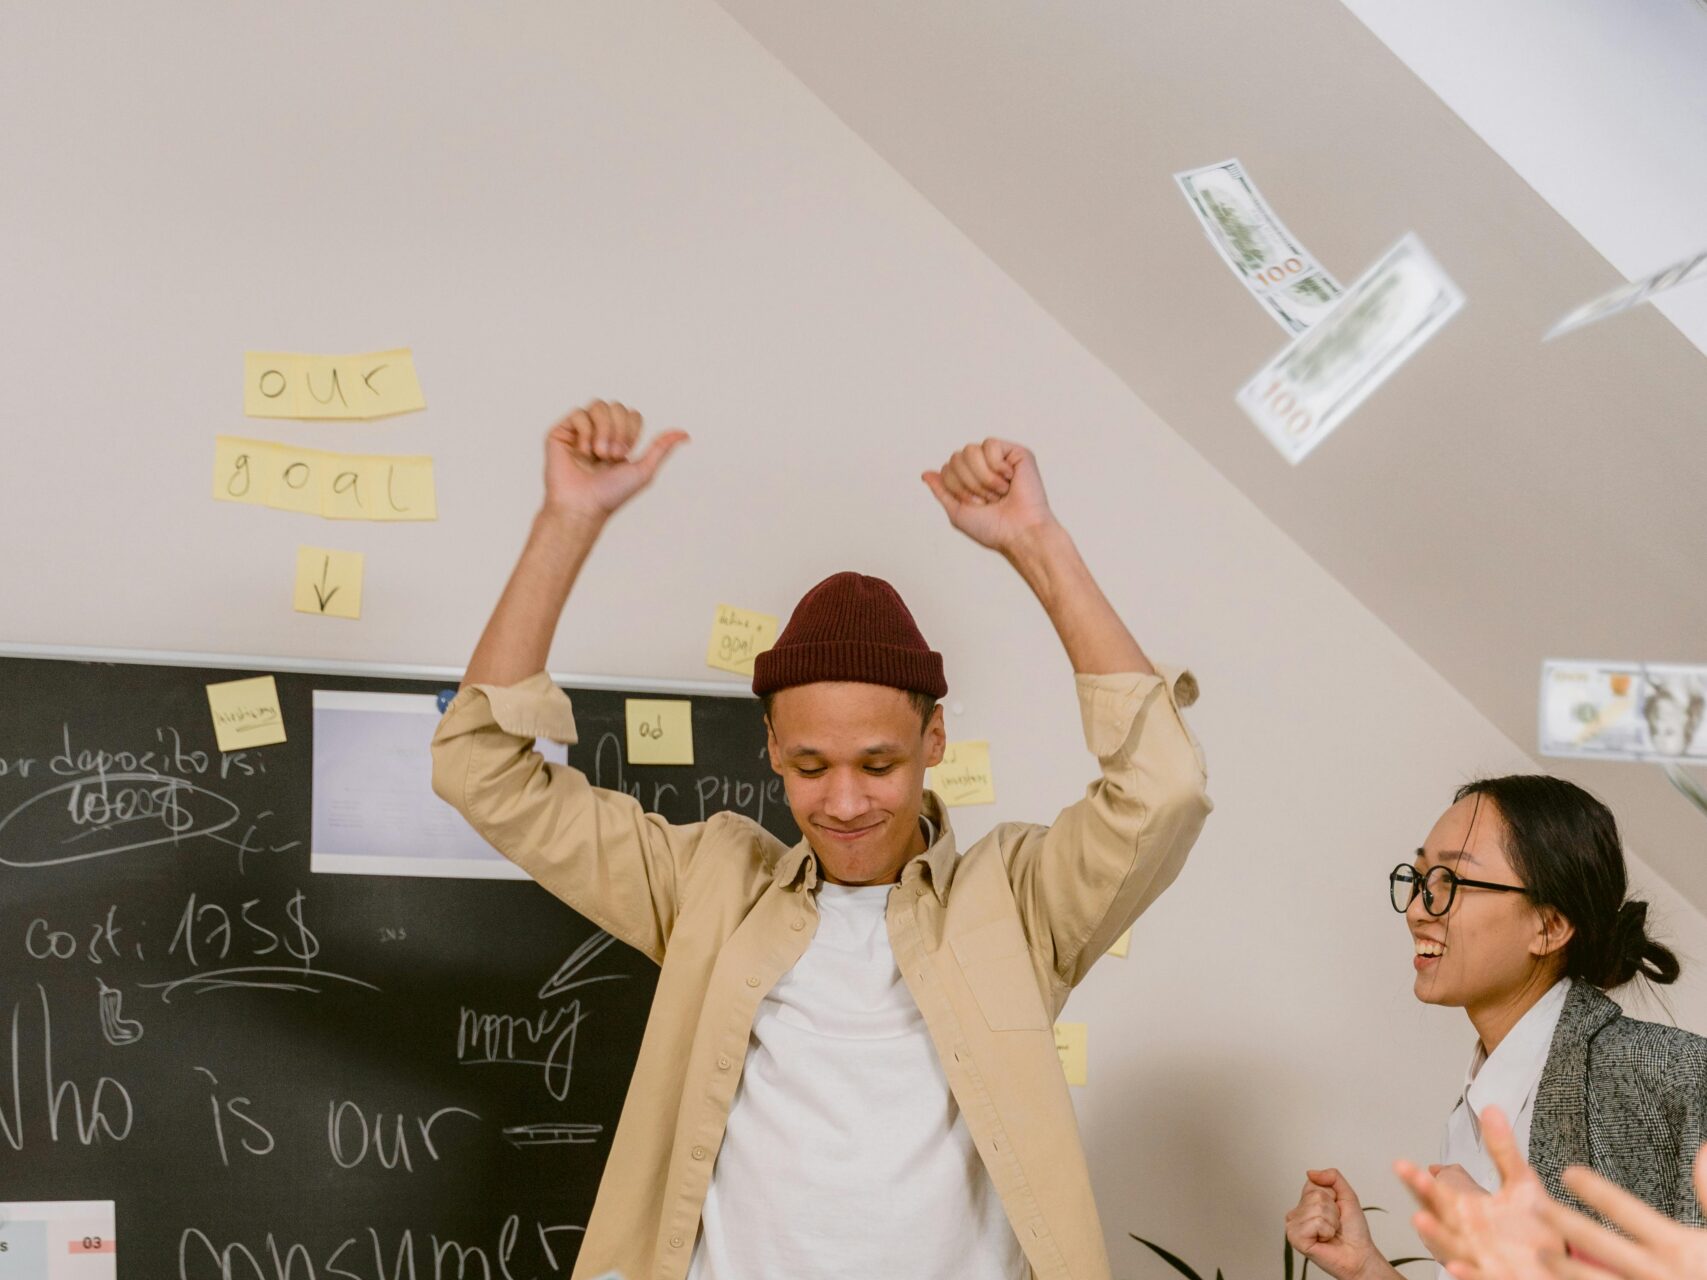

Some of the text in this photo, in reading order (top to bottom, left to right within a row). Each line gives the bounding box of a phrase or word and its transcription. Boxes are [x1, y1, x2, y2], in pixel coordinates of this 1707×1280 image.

[1256, 258, 1302, 286] 100
[259, 364, 389, 408] our
[227, 454, 411, 512] goal
[639, 714, 664, 740] ad
[168, 889, 320, 977] 175$
[193, 1067, 275, 1166] is
[327, 1100, 482, 1172] our
[82, 1236, 102, 1249] 03
